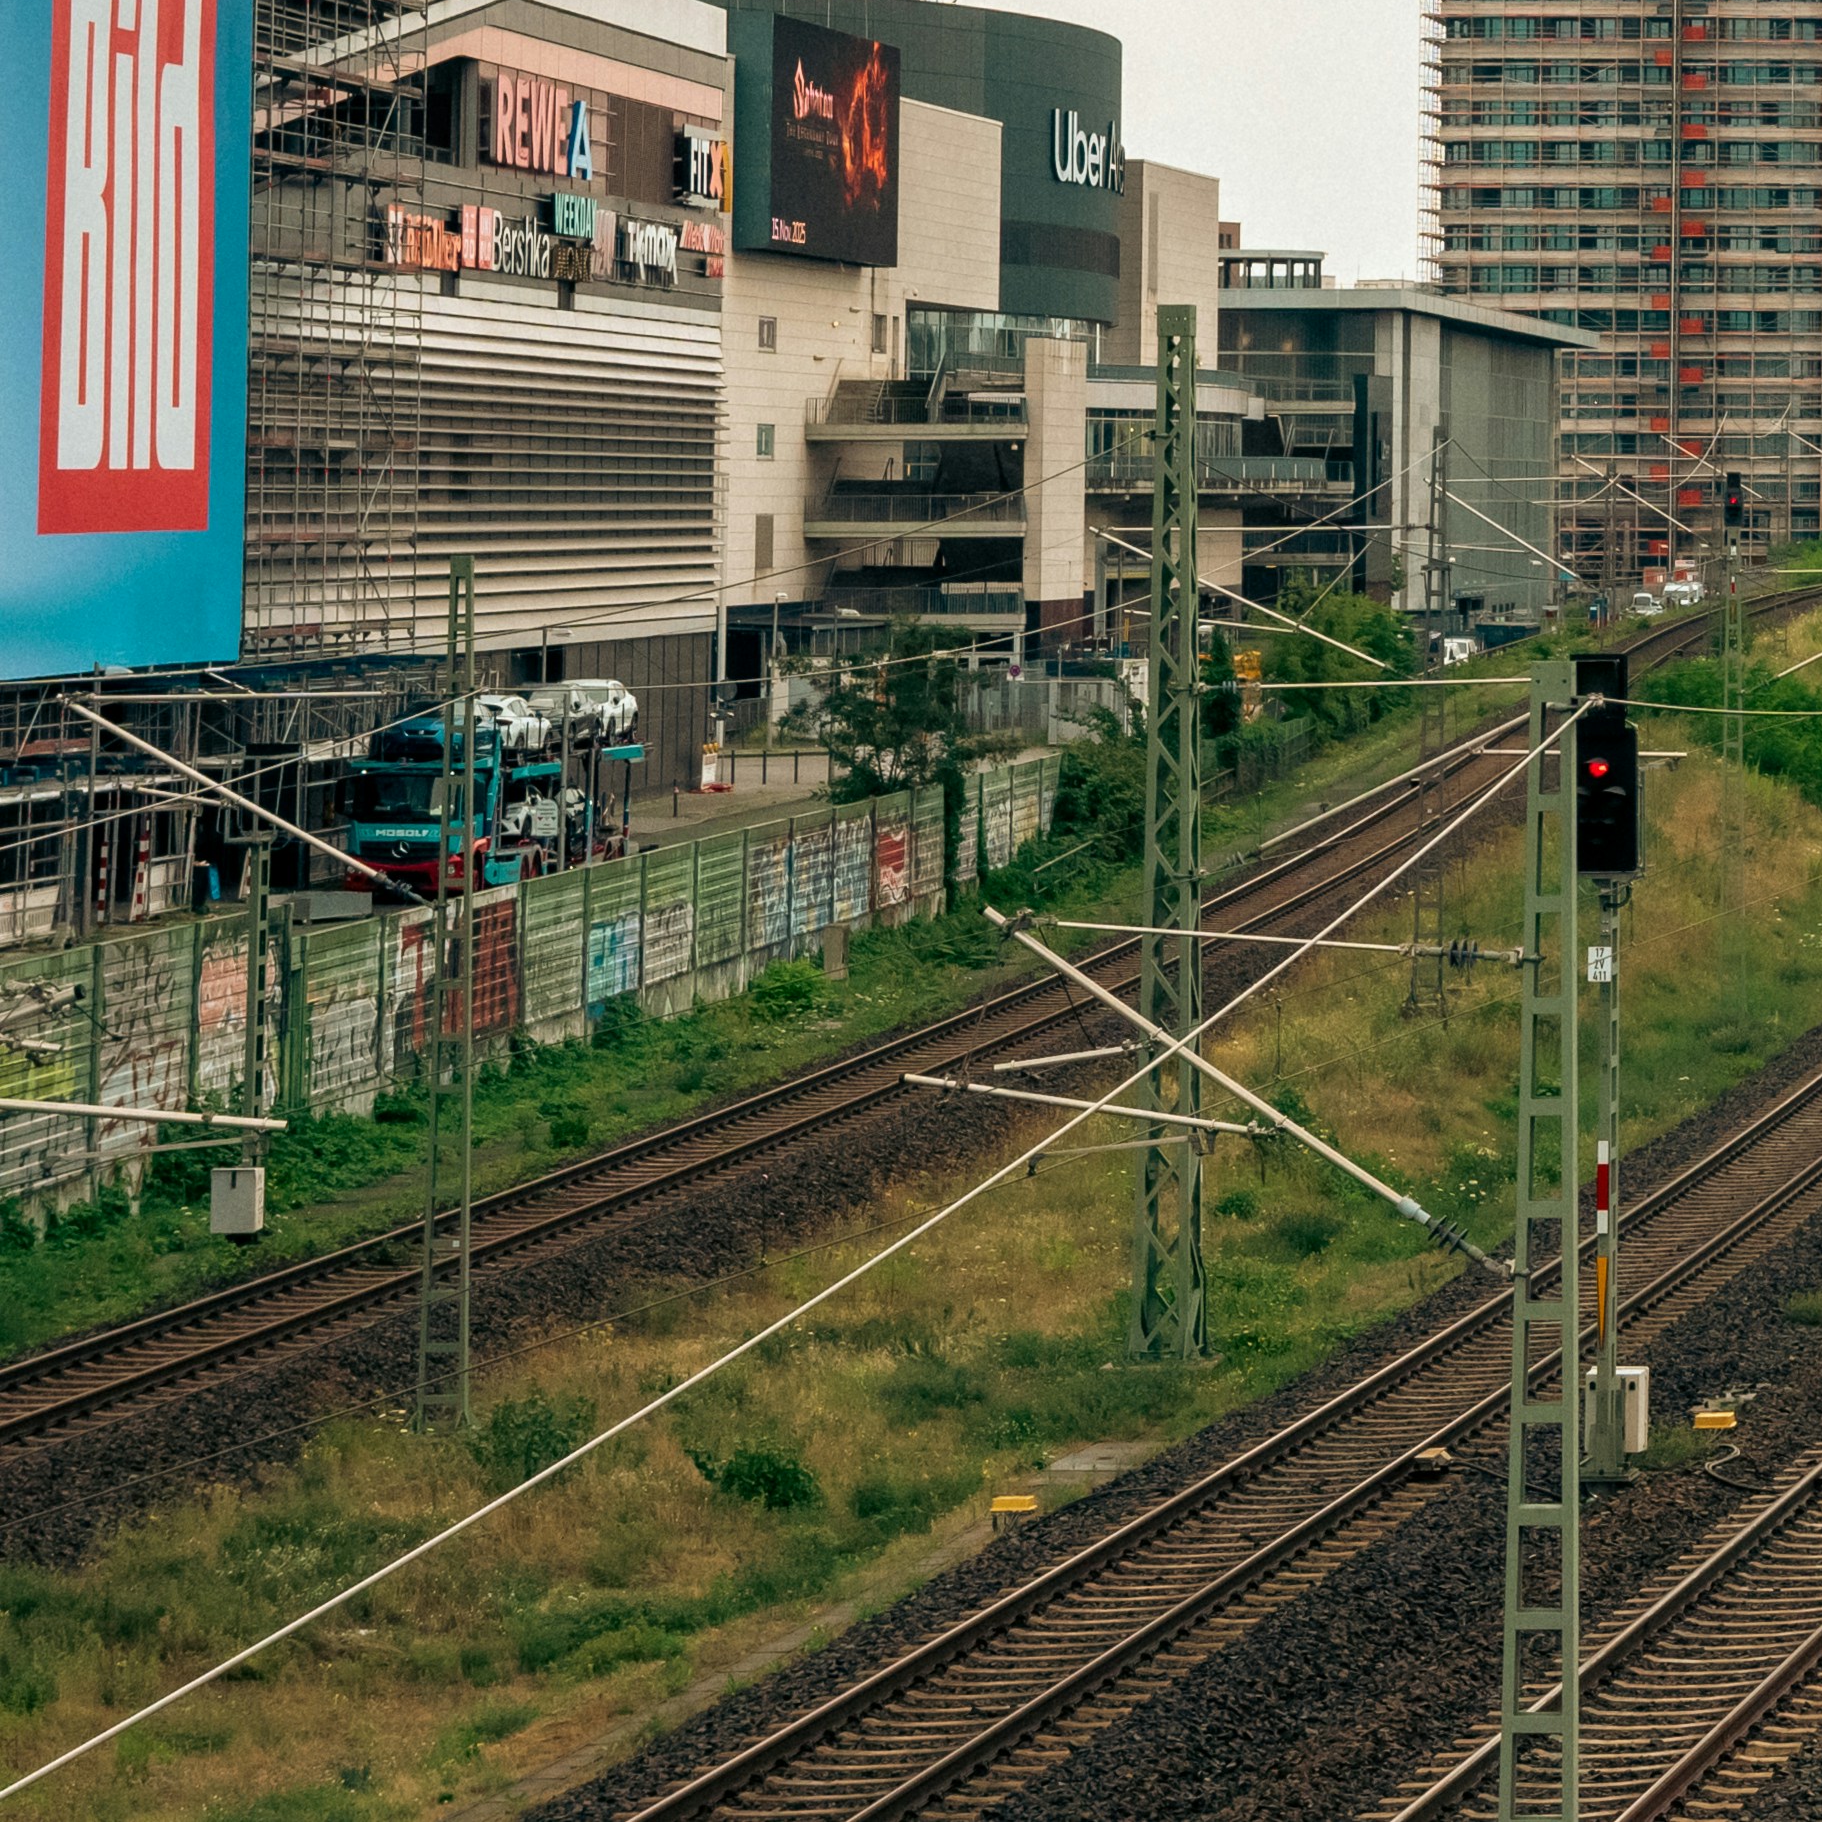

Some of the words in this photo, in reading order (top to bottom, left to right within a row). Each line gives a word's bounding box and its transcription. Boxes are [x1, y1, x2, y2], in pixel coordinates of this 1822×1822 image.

[497, 74, 569, 176] REWE
[1055, 108, 1106, 187] Uber
[555, 192, 598, 239] WEEKDAY
[492, 210, 550, 278] Bershka
[376, 829, 429, 837] MOSOLF
[1593, 971, 1606, 980] 411
[1596, 947, 1604, 957] 17
